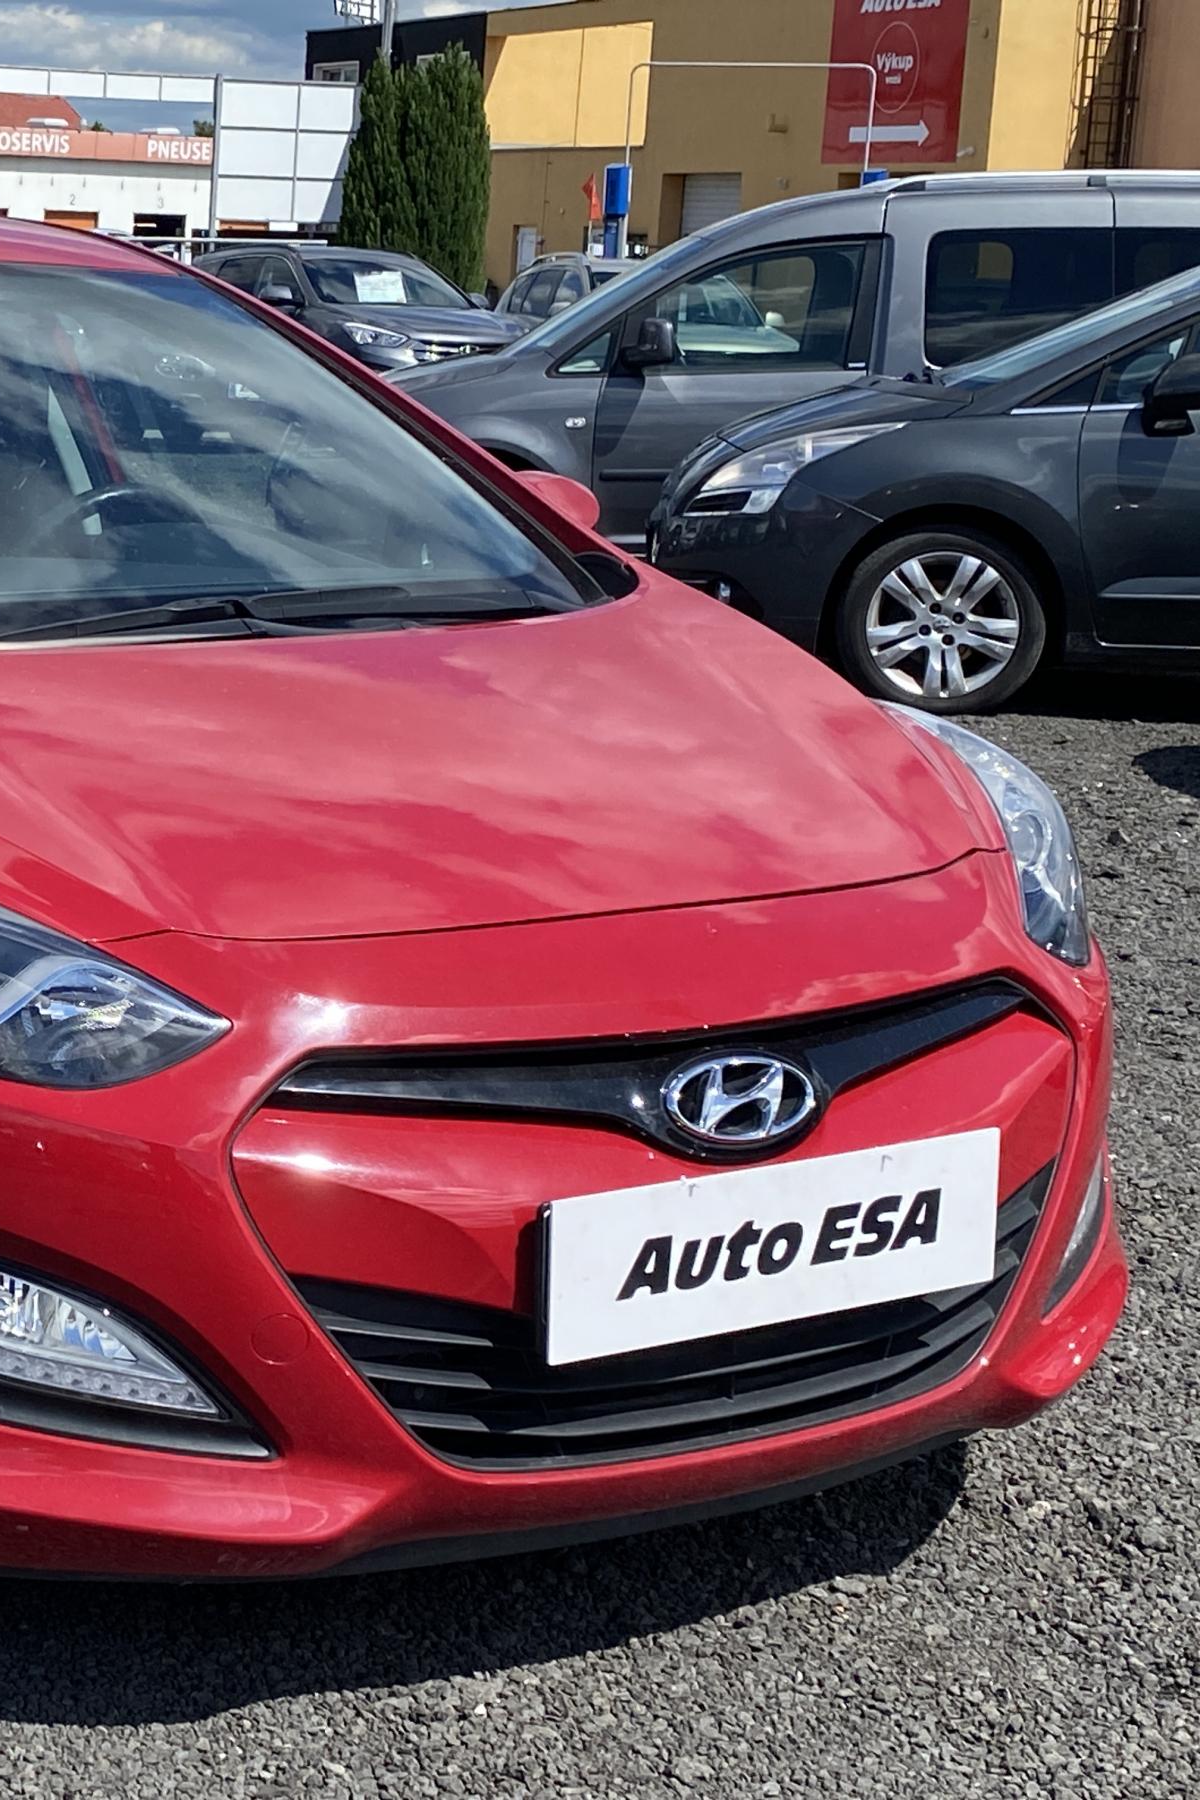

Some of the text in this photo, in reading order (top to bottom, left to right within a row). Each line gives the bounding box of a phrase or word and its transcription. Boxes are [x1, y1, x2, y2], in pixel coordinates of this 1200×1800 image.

[876, 52, 914, 73] Výkup
[147, 139, 211, 161] PNEUSE
[69, 193, 76, 206] 2
[615, 1187, 942, 1301] Auto ESA
